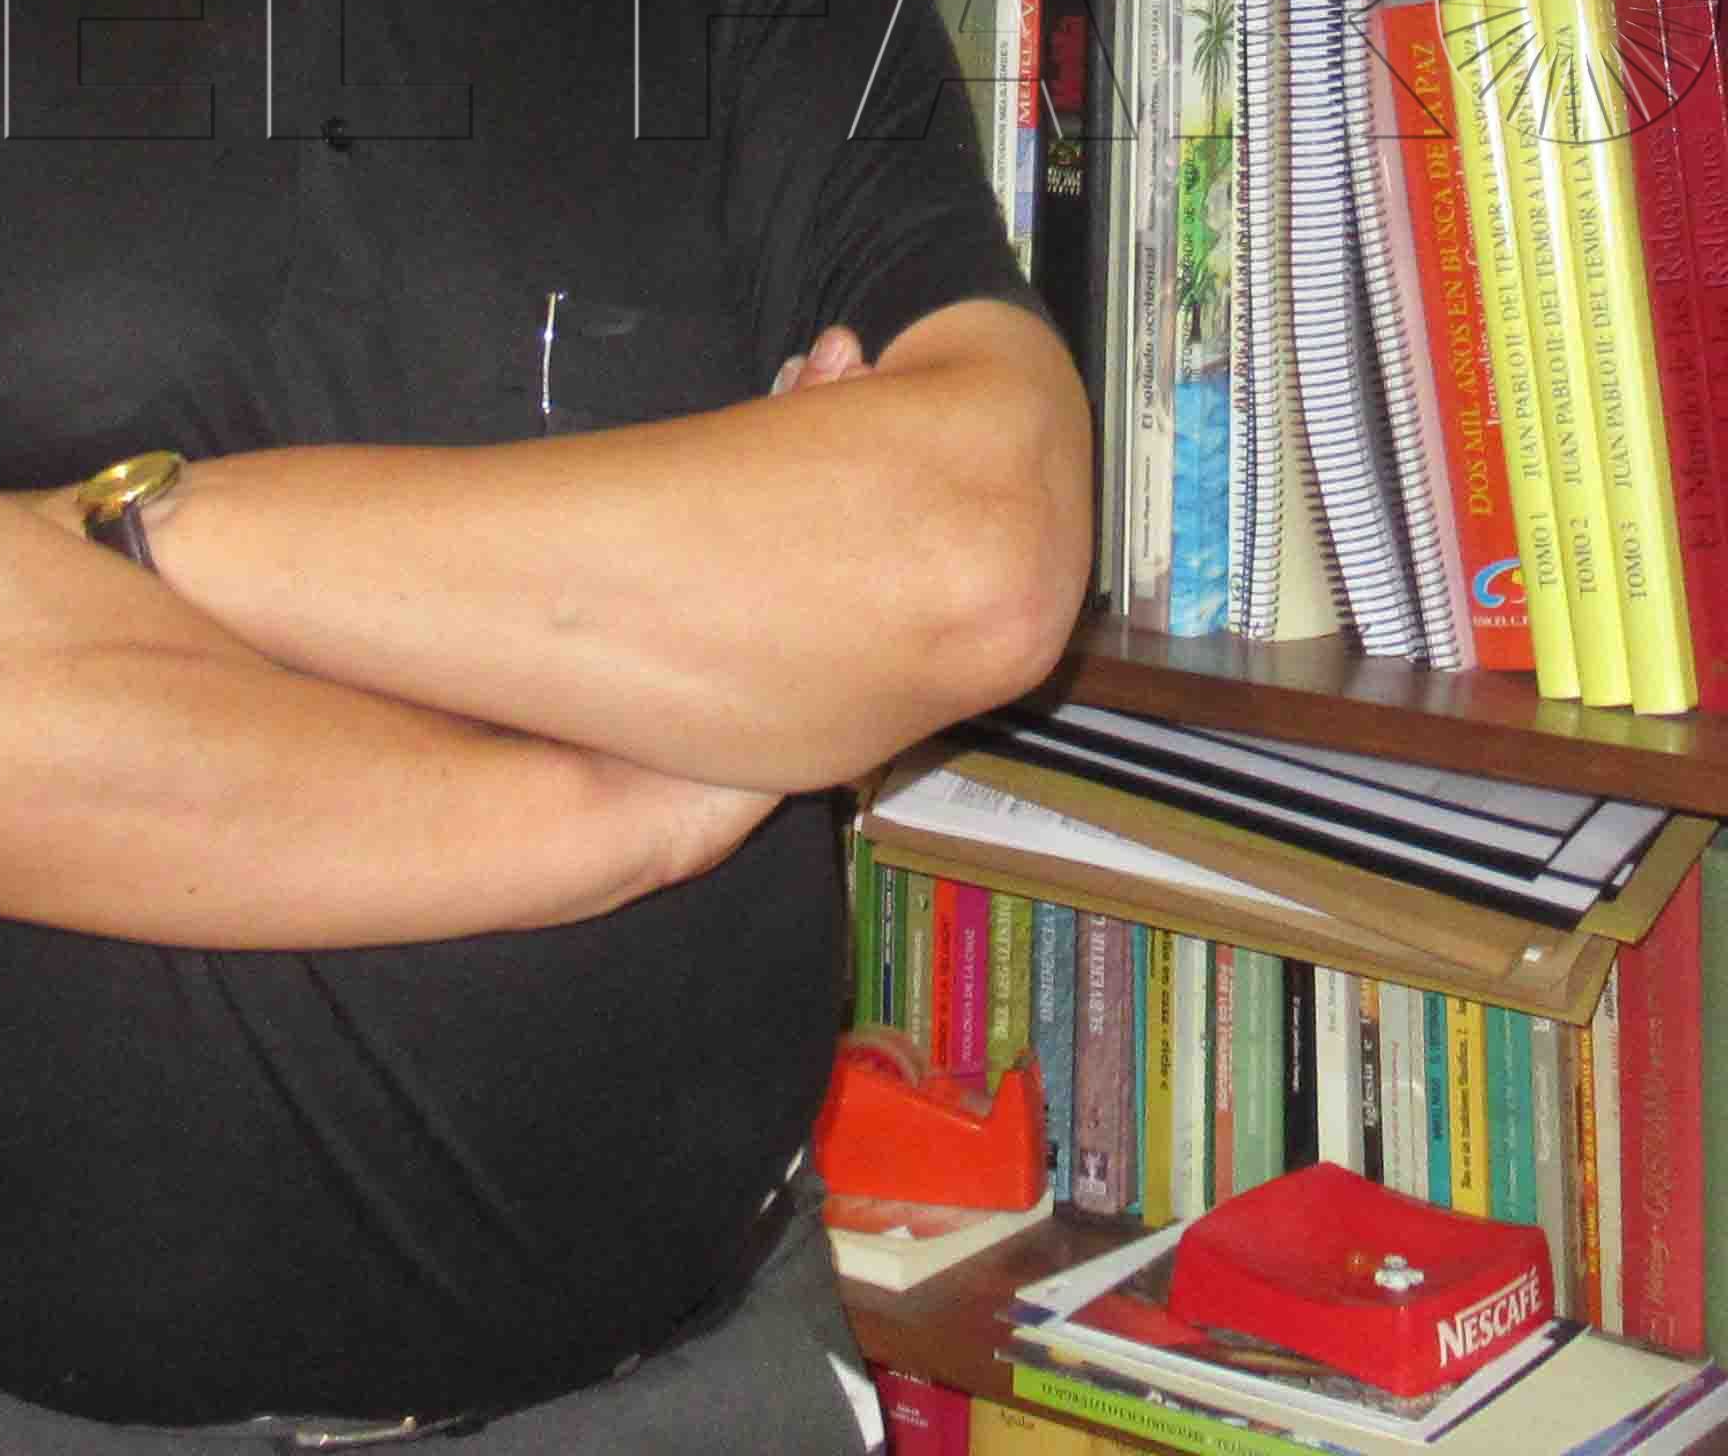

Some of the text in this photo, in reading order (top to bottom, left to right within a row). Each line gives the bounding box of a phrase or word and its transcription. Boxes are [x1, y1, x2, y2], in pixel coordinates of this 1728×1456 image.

[1018, 28, 1033, 126] MELILLA
[1140, 246, 1156, 410] soldado occidental
[1409, 43, 1493, 516] DOS MIL AÑOS EN BUSCA DE LA PAZ
[1487, 204, 1558, 590] TOMO JUAN PABLO DEL TEMOR
[1521, 155, 1598, 596] TOMO JUAN PABLO DEL TEMOR LA
[1572, 154, 1648, 601] TOMO JUAN PABLO DEL TEMOR LA
[1436, 1263, 1542, 1370] NESCAFÉ
